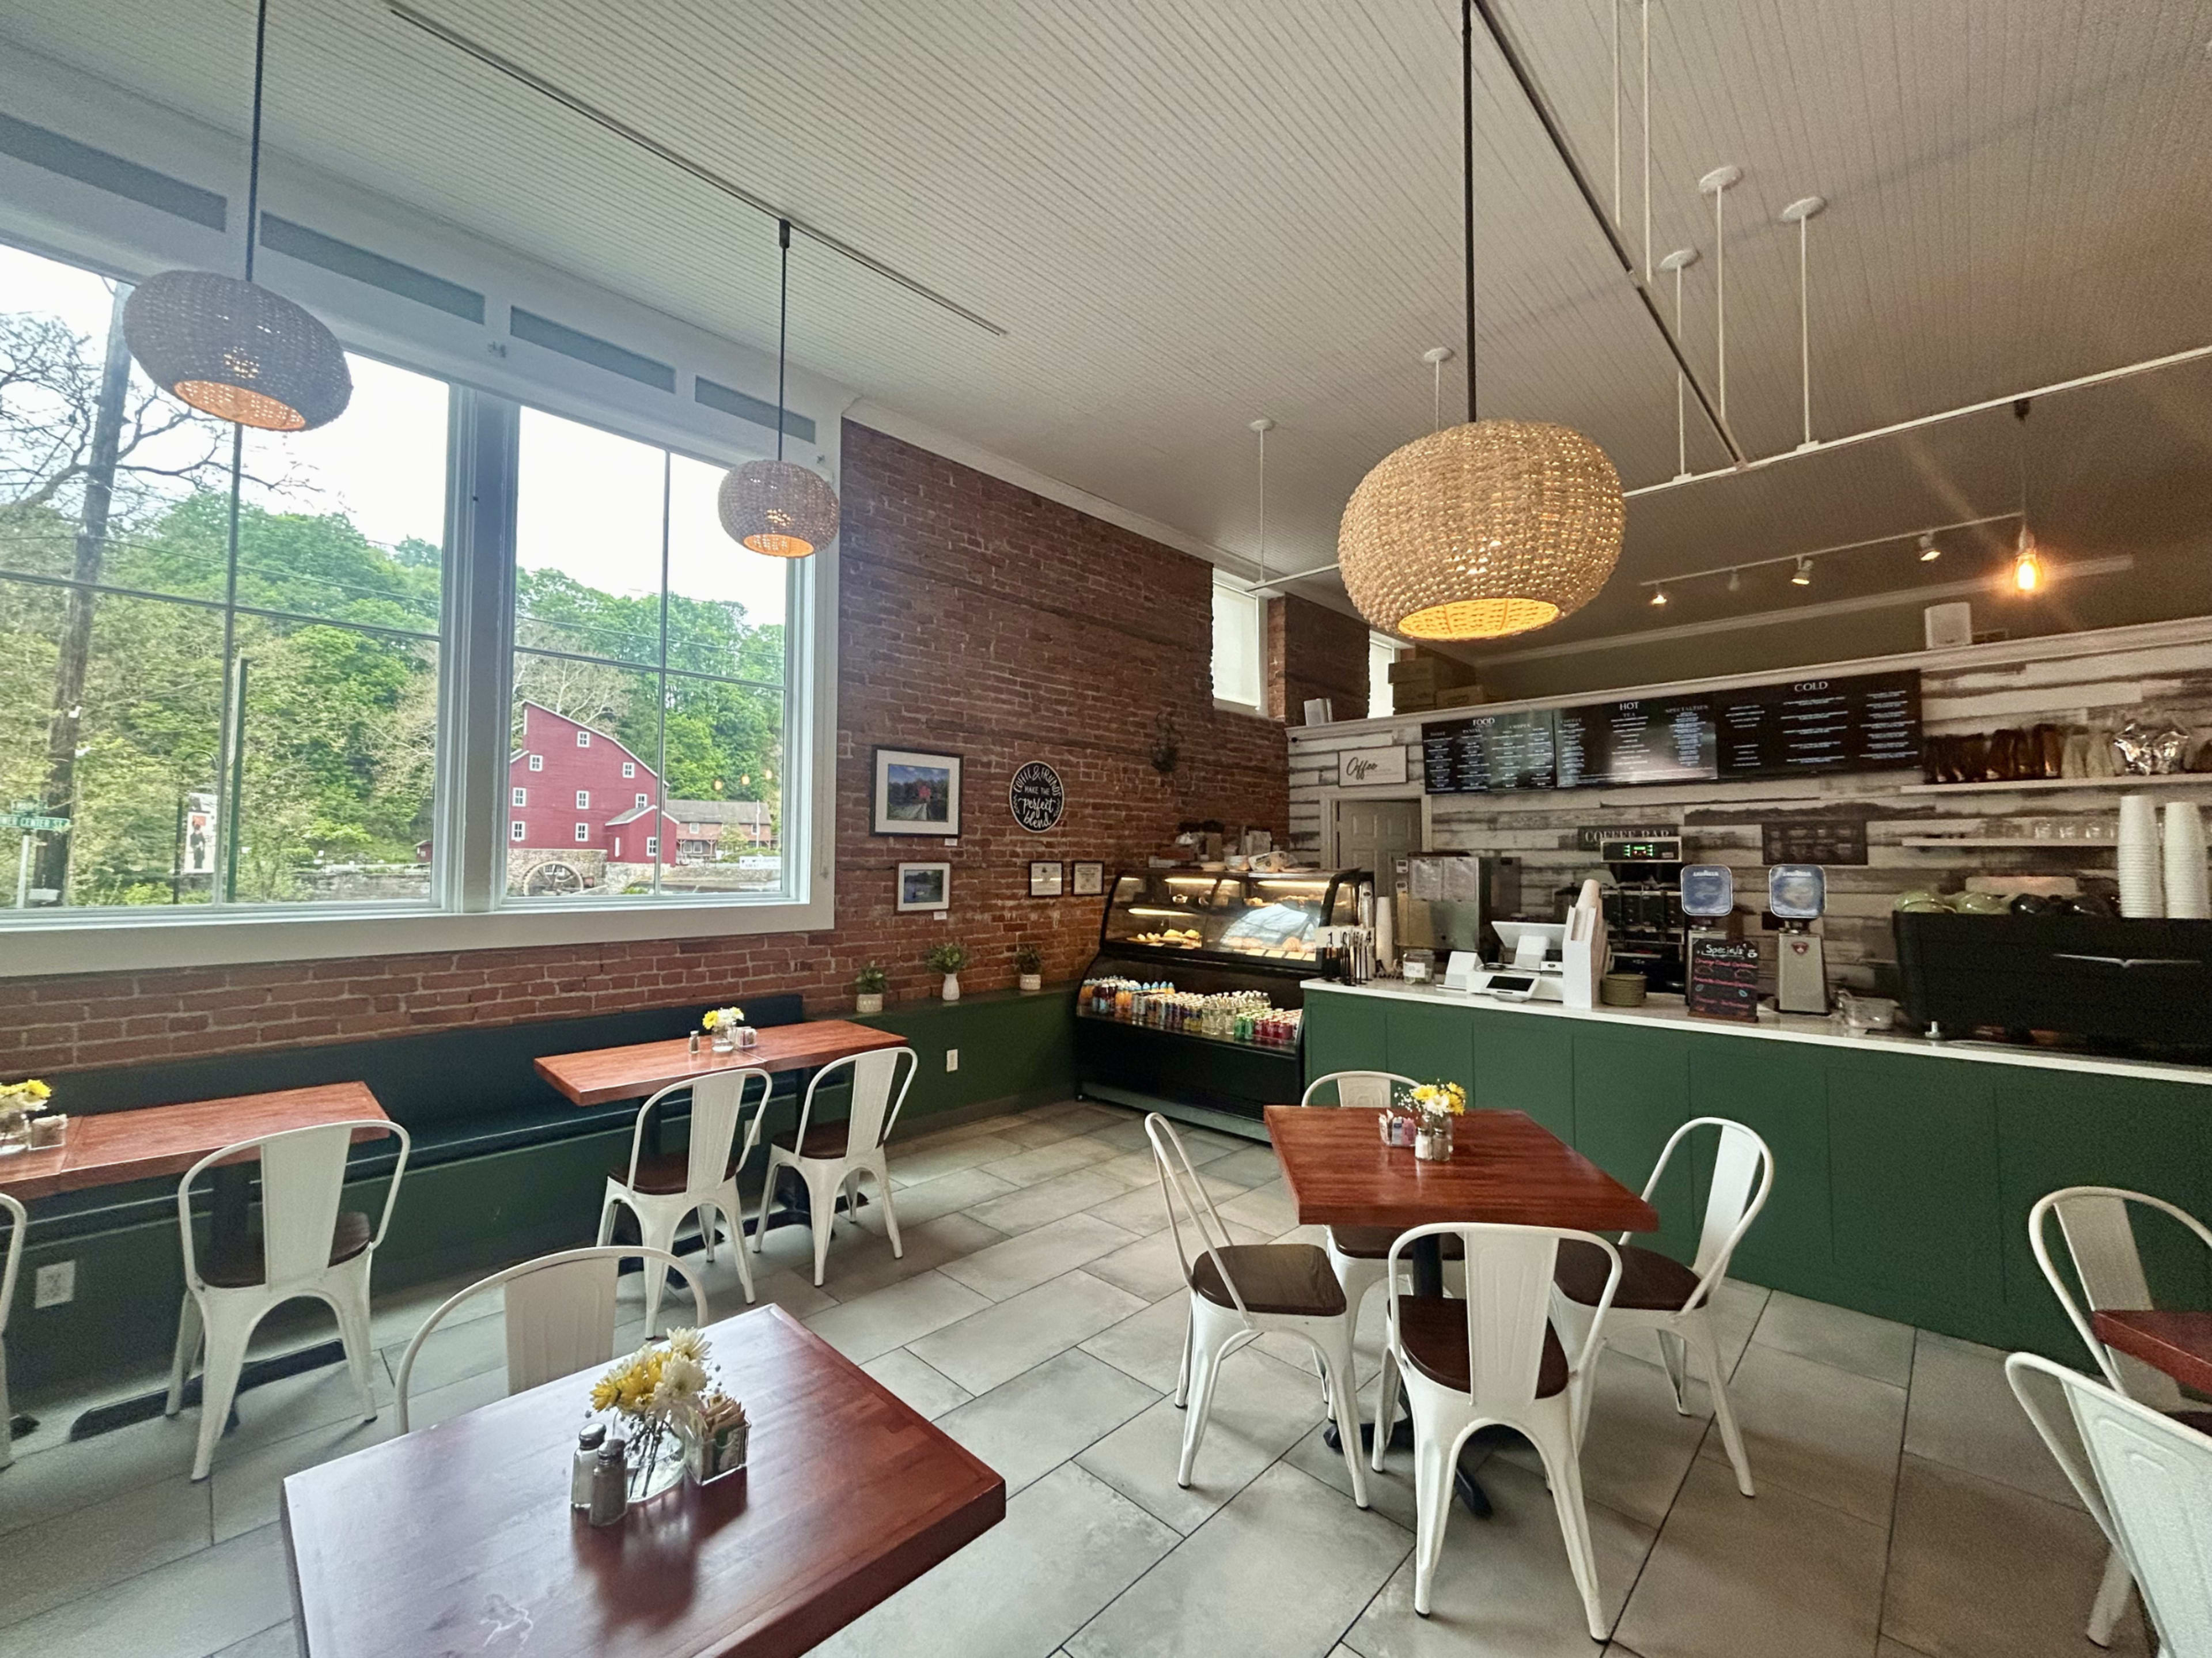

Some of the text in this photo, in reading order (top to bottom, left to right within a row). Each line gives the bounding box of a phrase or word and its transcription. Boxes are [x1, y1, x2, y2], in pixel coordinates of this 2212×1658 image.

[1794, 682, 1828, 691] COLD
[1620, 702, 1639, 710] HOT
[1472, 718, 1495, 726] FOOD
[1032, 766, 1041, 781] &
[1346, 757, 1378, 780] Coffee
[1024, 786, 1038, 794] MAKE
[1018, 797, 1056, 818] perfect
[20, 817, 50, 828] CENTER
[1024, 810, 1052, 828] blend
